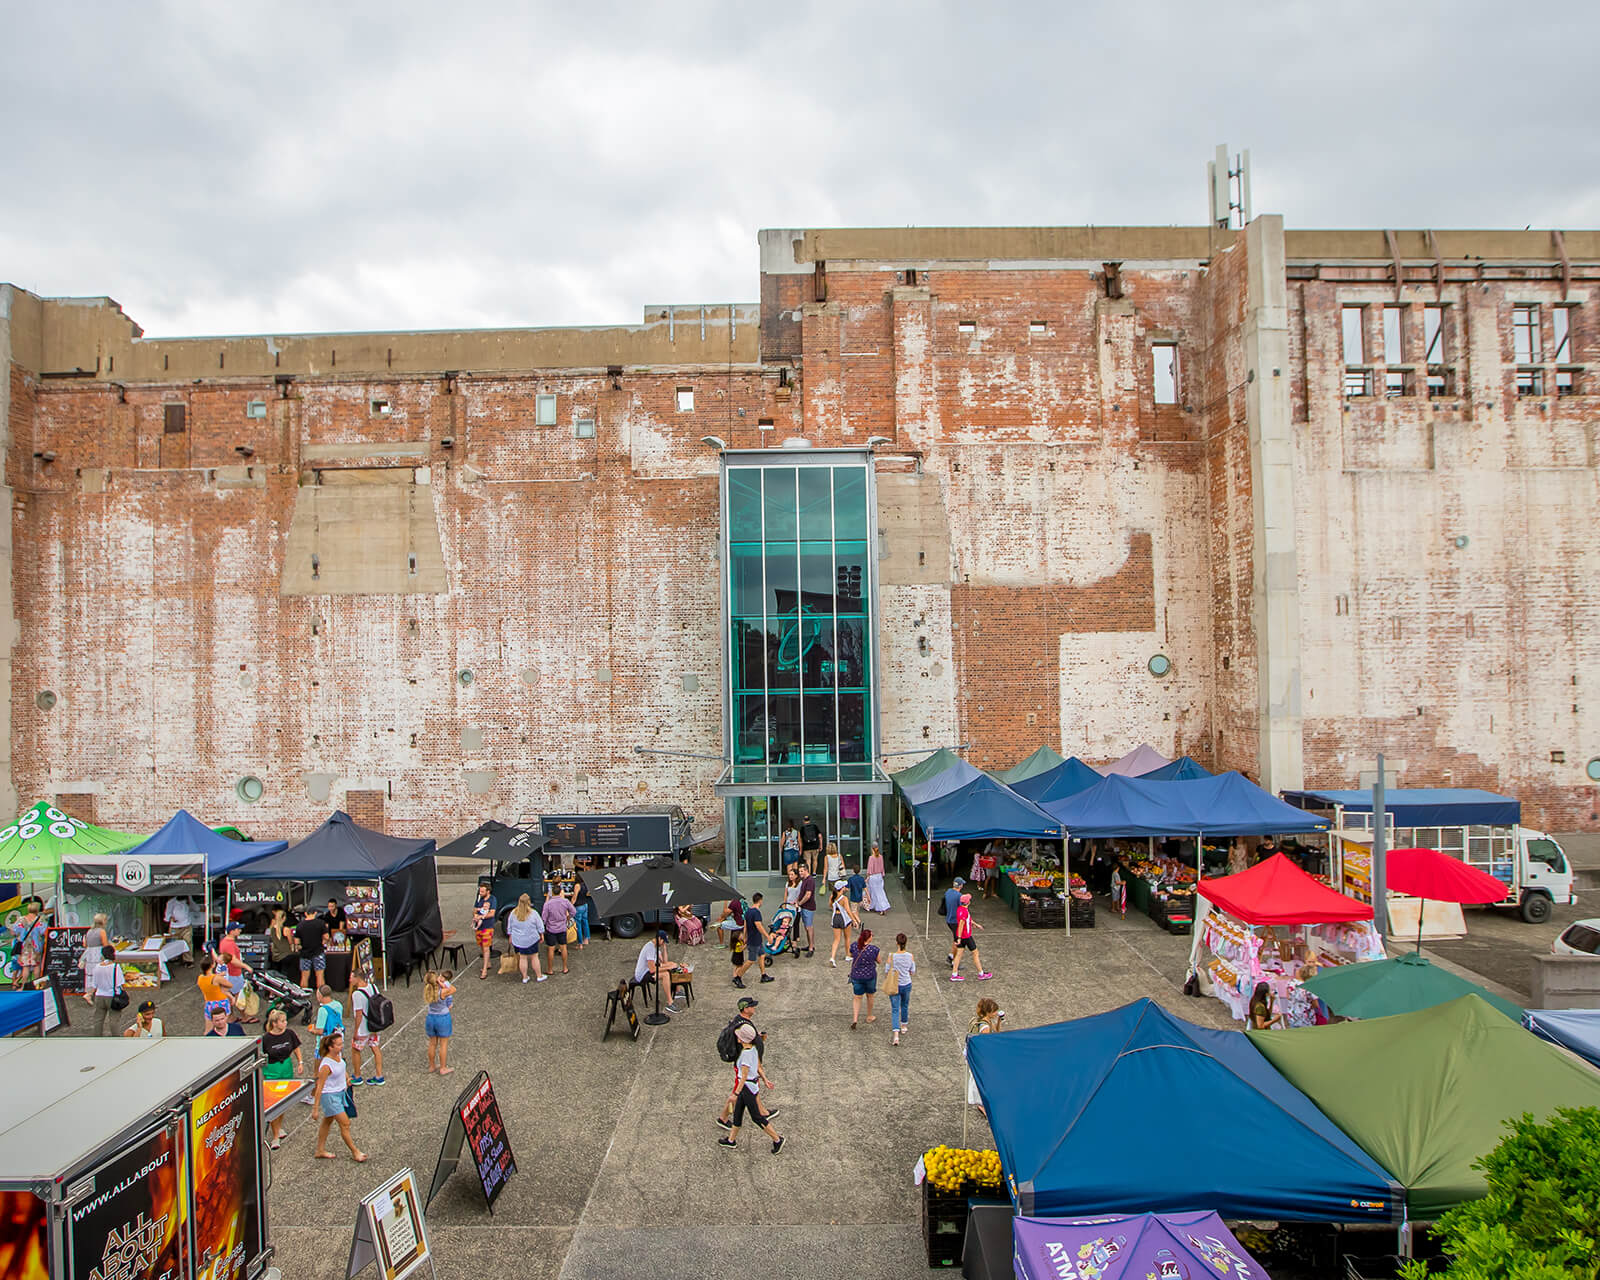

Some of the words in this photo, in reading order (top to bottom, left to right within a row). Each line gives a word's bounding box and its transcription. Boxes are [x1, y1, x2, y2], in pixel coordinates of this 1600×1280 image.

[125, 871, 142, 880] 60
[234, 892, 245, 902] The
[196, 1082, 249, 1129] MEAT.COM.AU
[73, 1151, 170, 1223] WWW.ALLABOUT
[102, 1212, 153, 1261] ALL
